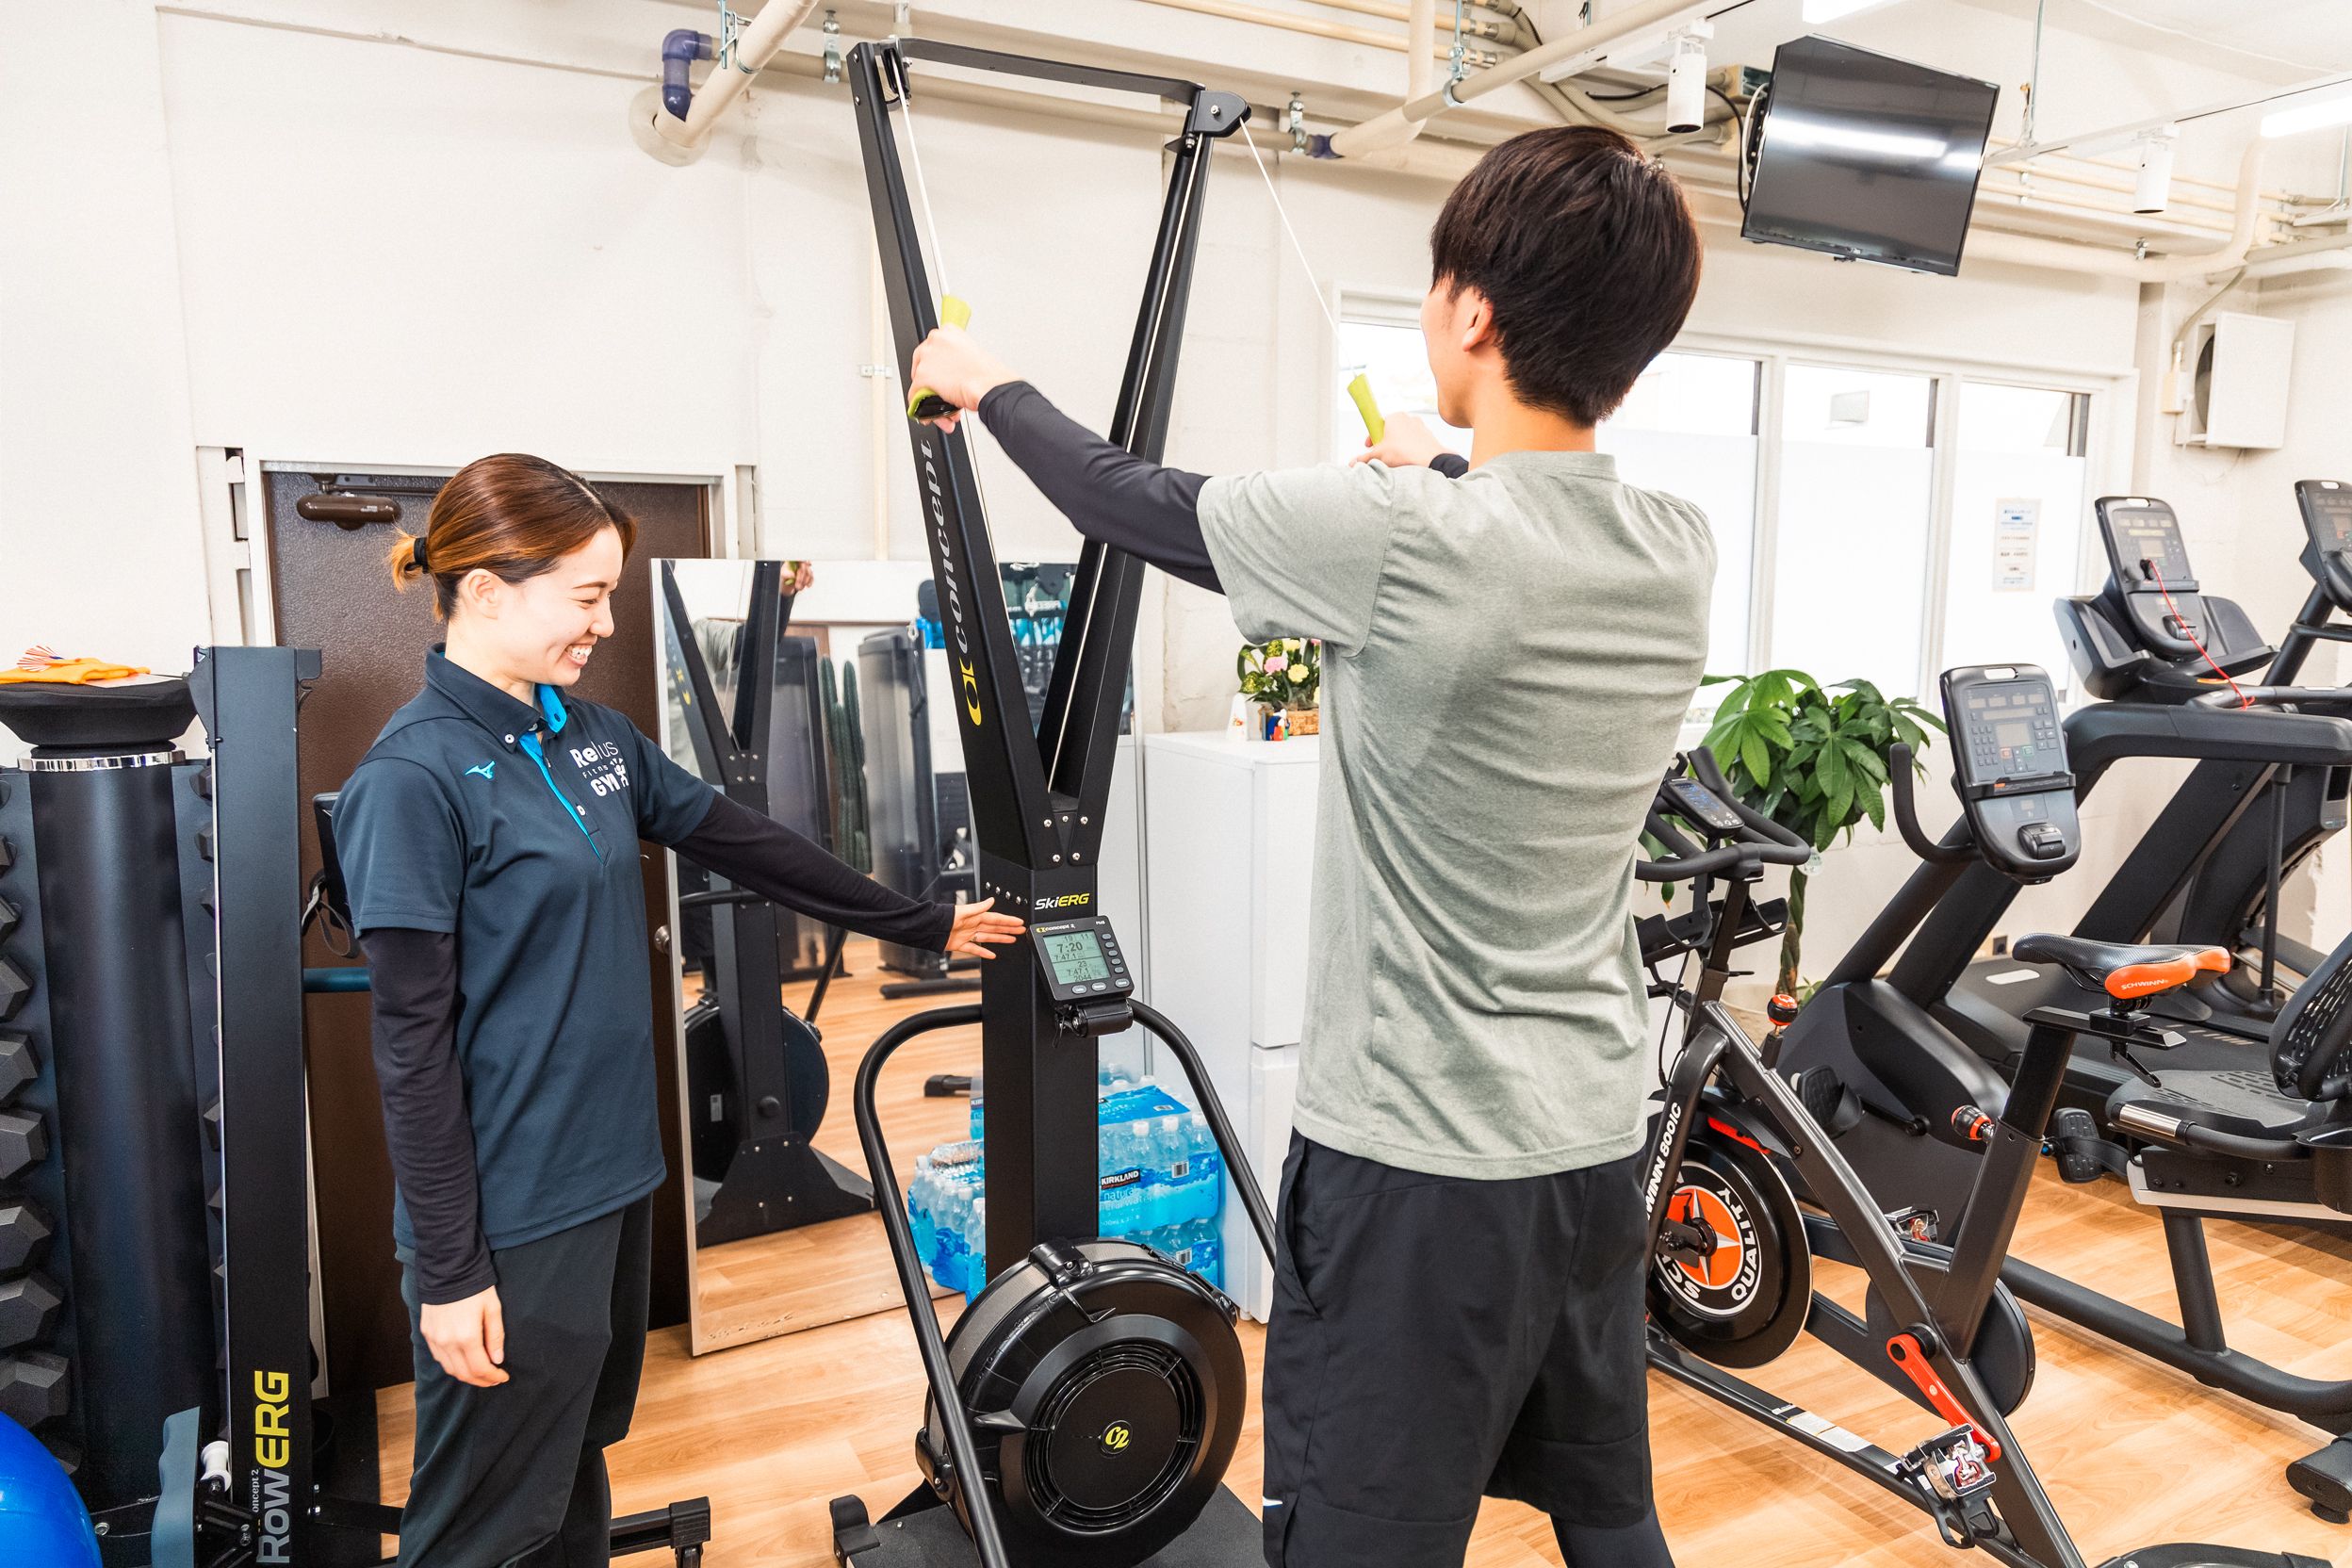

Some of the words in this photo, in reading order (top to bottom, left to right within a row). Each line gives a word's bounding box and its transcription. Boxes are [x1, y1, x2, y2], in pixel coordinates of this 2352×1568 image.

[920, 438, 969, 655] concept
[1057, 942, 1084, 954] 7:20
[2120, 979, 2164, 990] SCHWINN
[1101, 1170, 1139, 1185] KIRKLAND
[1103, 1184, 1137, 1200] natural
[1716, 1187, 1758, 1300] QUALITY
